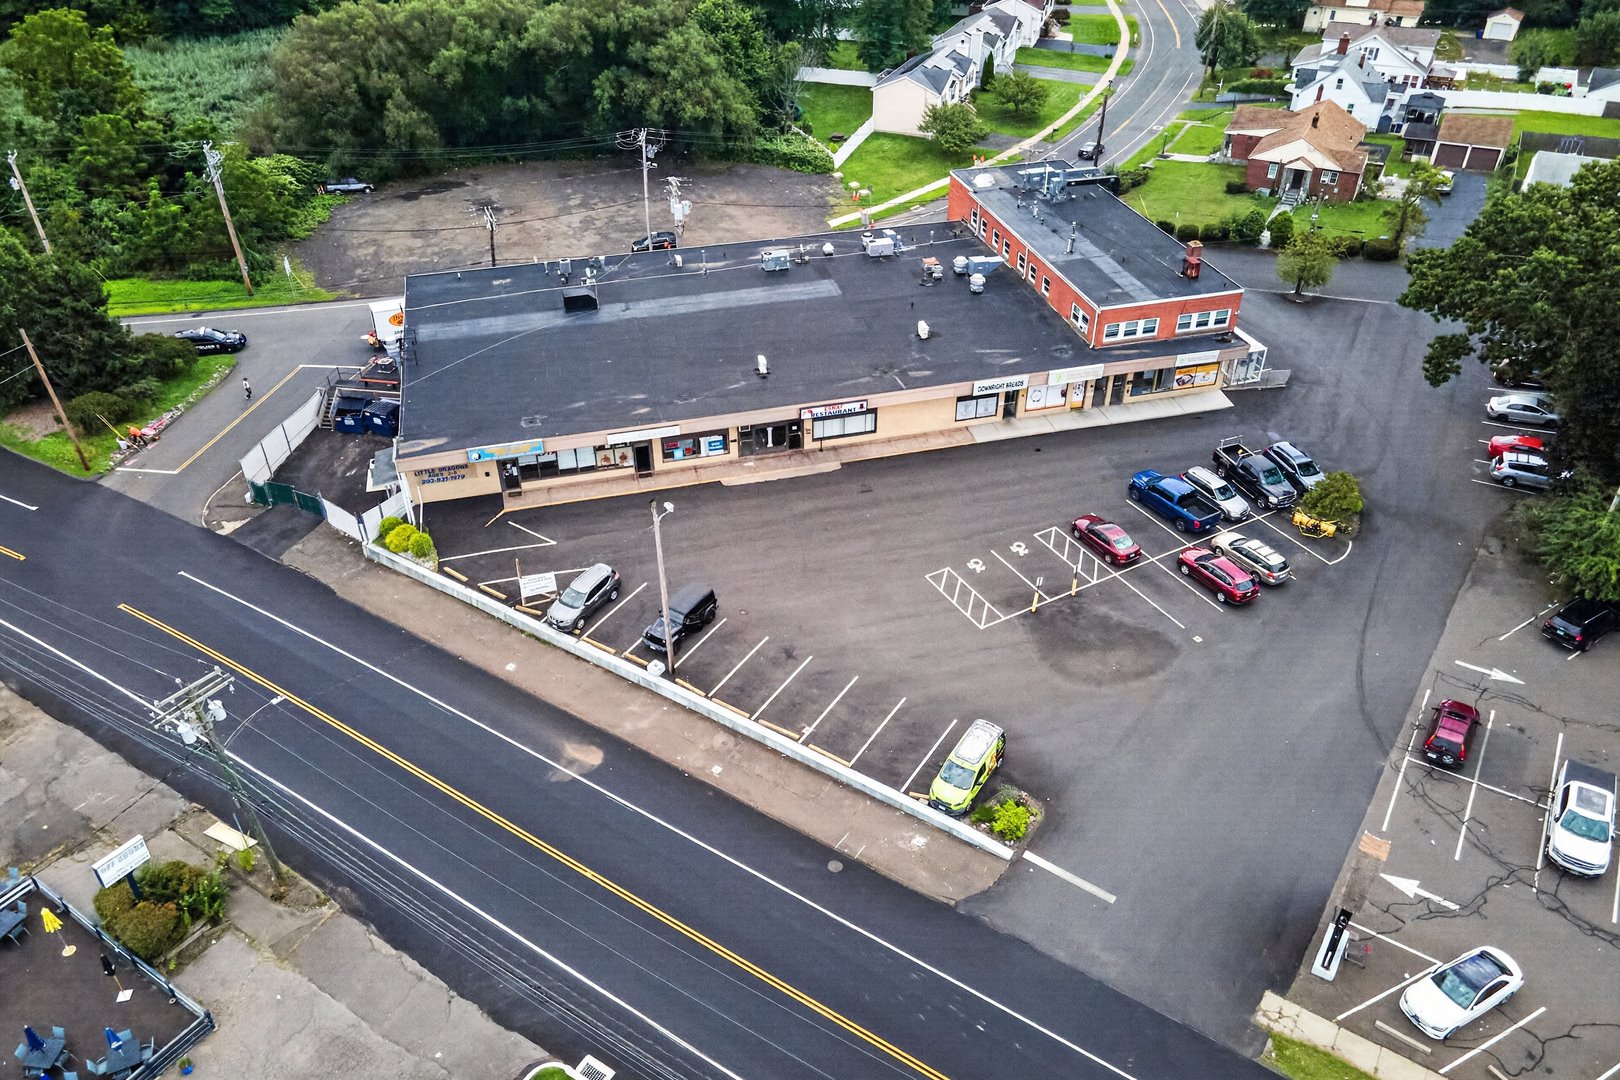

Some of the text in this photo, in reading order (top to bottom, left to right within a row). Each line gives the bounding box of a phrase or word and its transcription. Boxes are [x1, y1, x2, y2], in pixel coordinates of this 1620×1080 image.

[977, 380, 1024, 392] DOWNRIGHT BREADS
[811, 408, 856, 417] RESTAURANT
[414, 464, 468, 477] LITTLE DRAGONS
